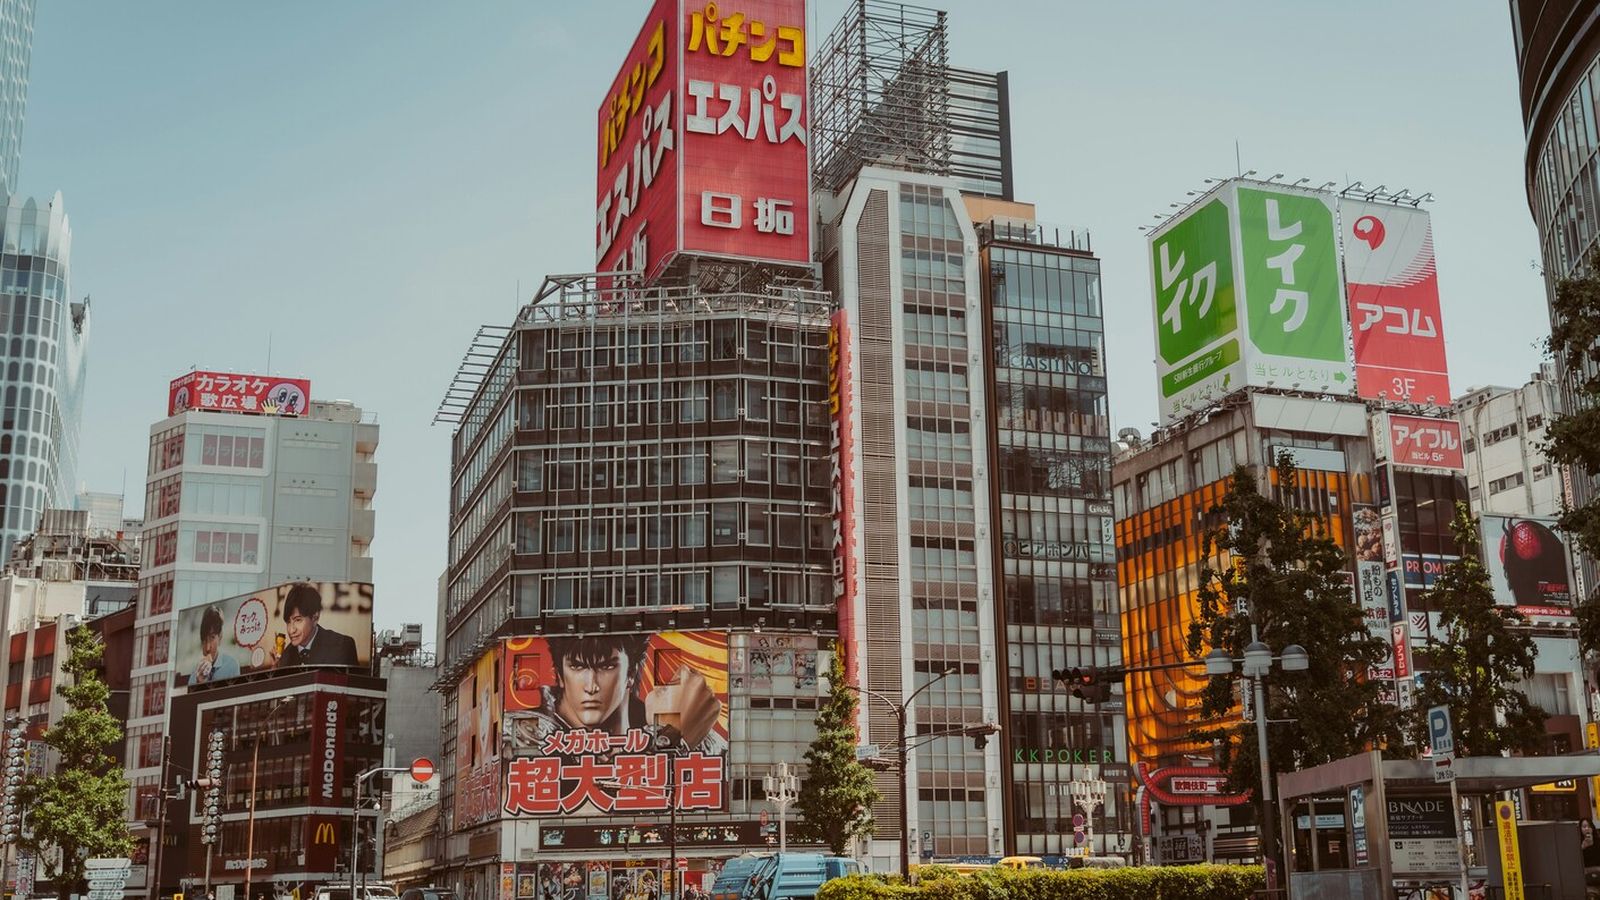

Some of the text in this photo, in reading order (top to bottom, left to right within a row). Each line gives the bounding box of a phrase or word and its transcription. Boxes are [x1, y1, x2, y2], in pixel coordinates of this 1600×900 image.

[688, 1, 804, 67] パチンコ
[602, 20, 665, 168] パチンコ
[687, 75, 806, 146] エスパス
[597, 90, 673, 262] エスパス
[701, 191, 794, 235] 日拓
[1265, 199, 1309, 332] レイク
[1159, 241, 1217, 334] レイク
[1357, 302, 1437, 338] アコム
[828, 323, 839, 415] パチンコ
[1010, 355, 1092, 375] CASINO
[196, 374, 269, 395] カラオケ
[200, 393, 258, 410] 歌広場
[1392, 378, 1415, 397] 3F
[204, 445, 264, 458] カラオケ
[1392, 424, 1458, 450] アイフル
[1431, 452, 1445, 462] 5F
[831, 420, 843, 550] エスパス
[1103, 518, 1113, 543] ダーツ
[322, 700, 338, 798] McDonald's
[543, 728, 650, 754] メガホール
[1430, 710, 1448, 750] P
[1015, 748, 1114, 763] KKPOKER
[507, 753, 722, 813] 超大型店
[1351, 795, 1359, 825] P
